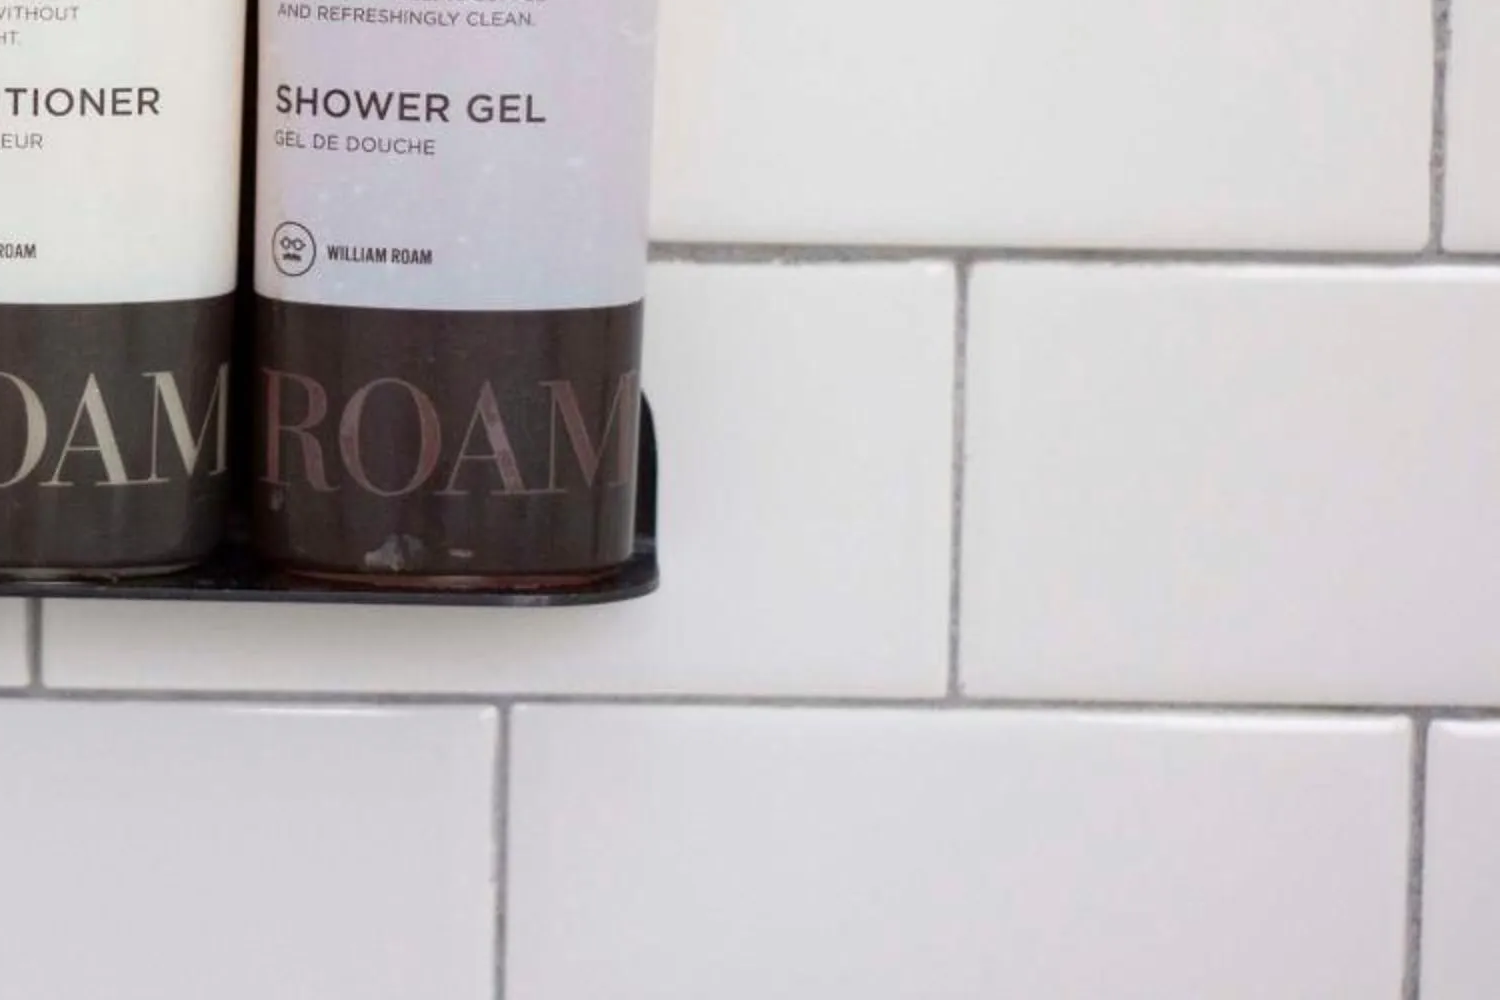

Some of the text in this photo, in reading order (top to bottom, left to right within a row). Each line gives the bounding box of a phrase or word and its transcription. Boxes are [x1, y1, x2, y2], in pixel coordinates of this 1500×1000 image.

[278, 3, 535, 27] AND REFRESHINGLY CLEAN.
[276, 84, 546, 124] SHOWER GEL
[274, 129, 436, 155] GEL DE DOUCHE
[326, 244, 432, 265] WILLIAM ROAM
[259, 367, 639, 497] ROAM
